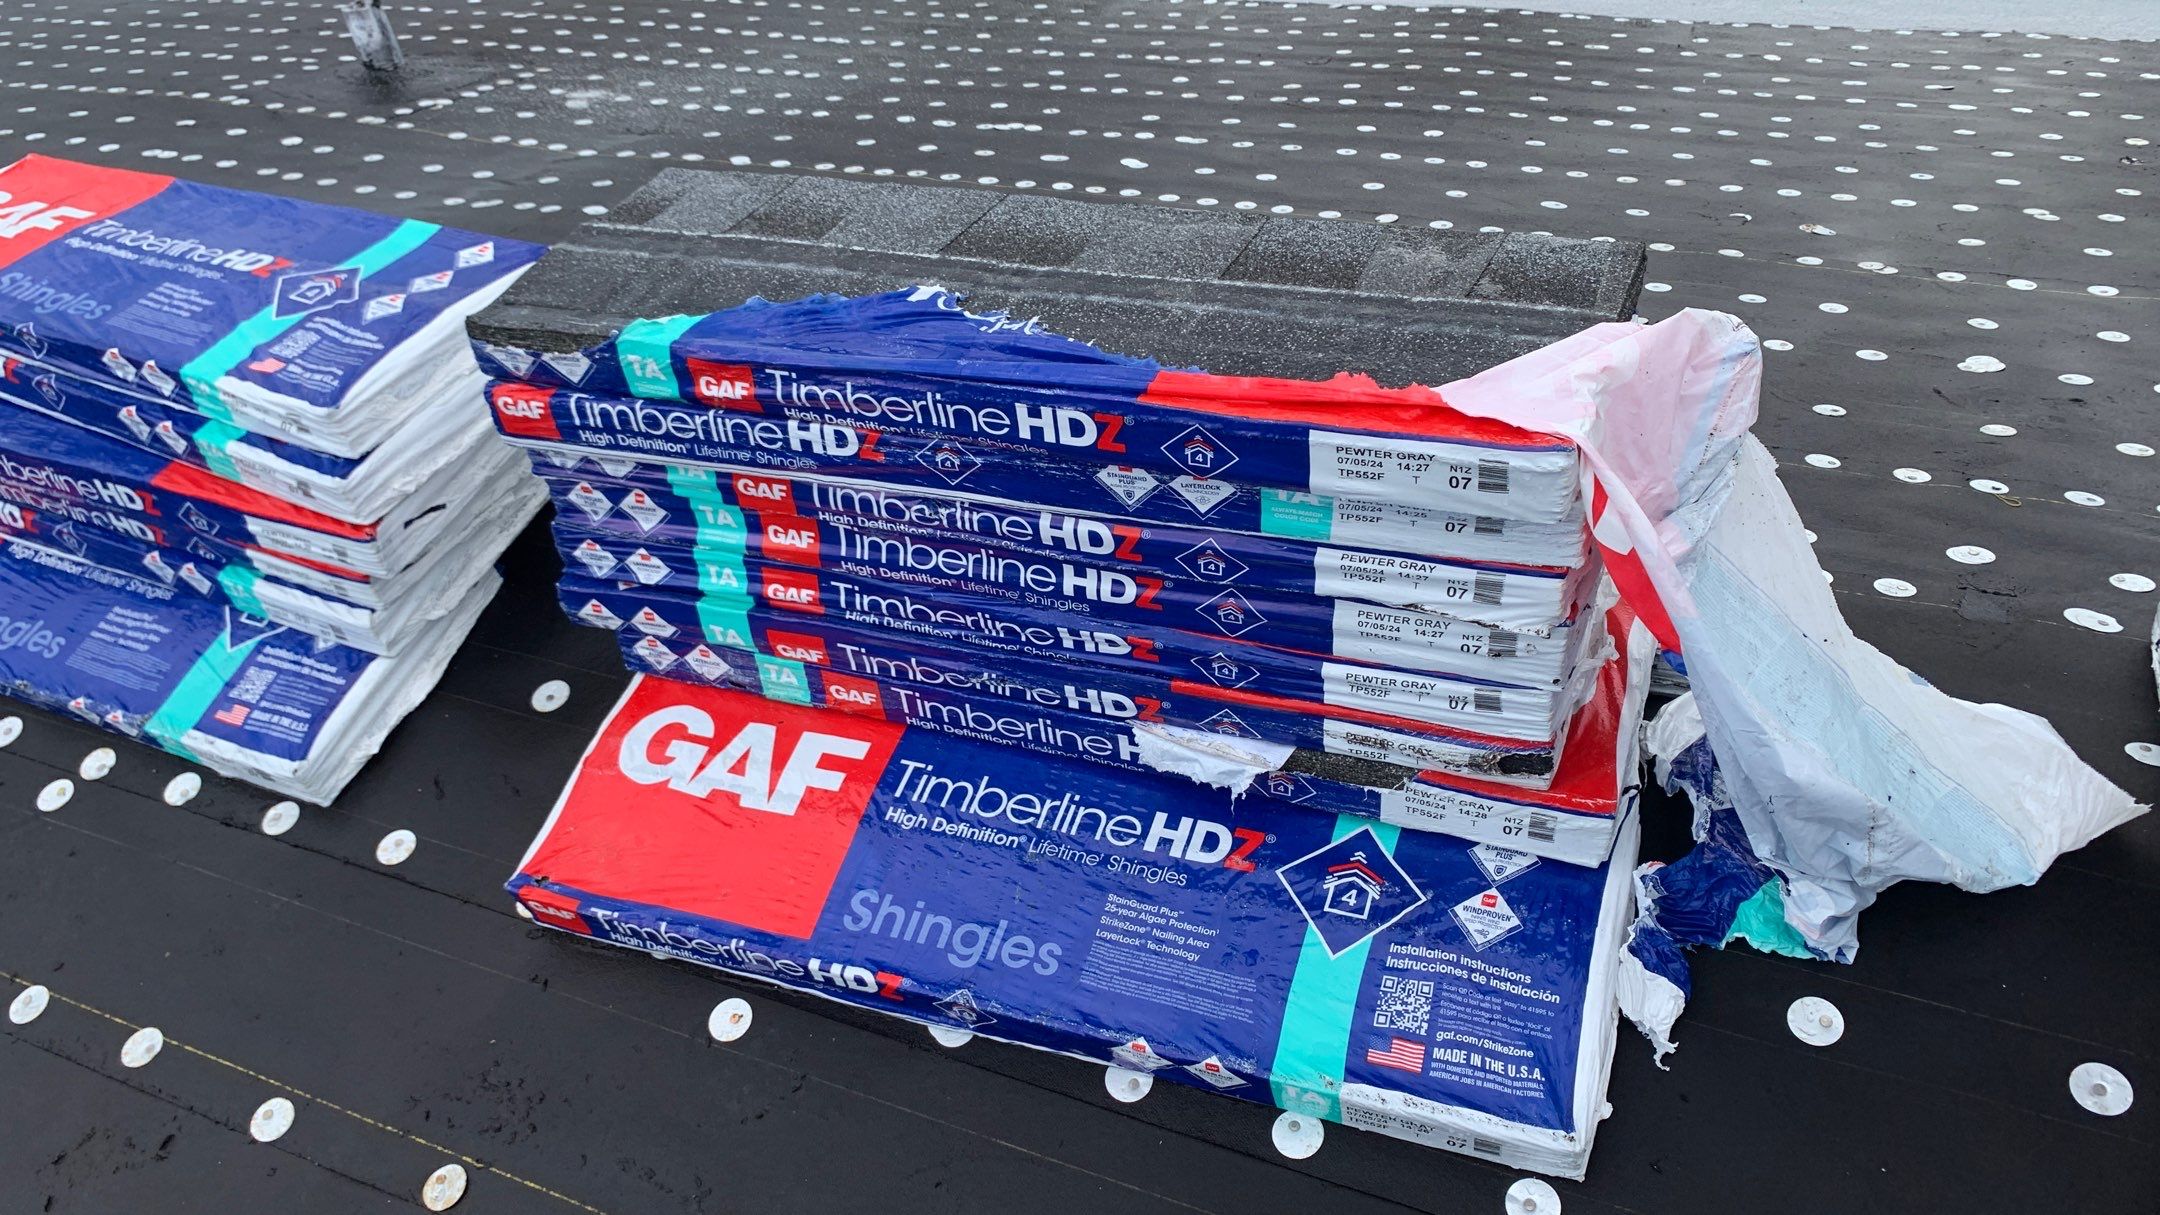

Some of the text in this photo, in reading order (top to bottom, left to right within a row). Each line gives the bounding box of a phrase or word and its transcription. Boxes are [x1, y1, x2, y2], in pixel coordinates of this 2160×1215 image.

[0, 271, 111, 320] Shingles
[625, 354, 668, 381] TA
[699, 374, 751, 401] GAF
[497, 396, 546, 420] GAF
[784, 406, 820, 423] High
[579, 429, 614, 447] High
[755, 451, 818, 470] Shingles
[1195, 453, 1204, 464] 4
[1336, 446, 1437, 462] PEWTER GRAY
[943, 459, 953, 469] 4
[1337, 456, 1430, 472] 07/05/24 14:27
[1449, 464, 1473, 475] N1Z
[0, 453, 162, 516] berlineHDZ
[1337, 468, 1421, 485] TP552F T
[1448, 475, 1473, 490] 07
[736, 478, 788, 501] GAF
[697, 504, 738, 529] TA
[818, 510, 852, 525] High
[1337, 503, 1383, 513] 07/05/24
[1338, 512, 1384, 524] TP552F
[767, 524, 816, 549] GAF
[1444, 521, 1469, 534] 07
[1207, 562, 1217, 571] 4
[1340, 564, 1429, 581] 07/05/24 14:27
[1341, 553, 1438, 574] PEWTER GRAY
[705, 564, 739, 588] TA
[1341, 572, 1388, 584] TP552F
[1447, 579, 1470, 587] N1Z
[767, 583, 816, 604] GAF
[840, 559, 877, 577] High
[1024, 591, 1091, 614] Shingles
[1446, 586, 1469, 600] 07
[845, 609, 880, 625] High
[1357, 610, 1452, 630] PEWTER GRAY
[709, 624, 746, 646] TA
[1357, 620, 1445, 639] 07/05/24 14:27
[1462, 633, 1484, 642] N1Z
[776, 643, 824, 663] GAF
[1460, 643, 1482, 655] 07
[763, 663, 799, 685] TA
[1345, 672, 1437, 691] PEWTER GRAY
[828, 684, 877, 705] GAF
[1349, 683, 1392, 699] TP552F
[1448, 699, 1470, 711] 07
[890, 687, 1140, 762] TimberlineH
[906, 716, 941, 731] High
[1397, 743, 1433, 756] GRAY
[618, 704, 872, 816] GAF
[1405, 785, 1495, 813] PEWTER GRAY
[1405, 795, 1488, 820] 07/05/24 14:28
[1405, 805, 1447, 820] TP552F
[1504, 816, 1525, 826] N1Z
[1502, 825, 1523, 837] 07
[884, 805, 928, 832] High
[1107, 854, 1188, 887] Shingles
[1107, 893, 1160, 914] StainGuard
[1341, 888, 1358, 906] 4
[528, 900, 577, 923] GAF
[1104, 902, 1138, 918] 25-year
[1138, 912, 1167, 926] Algae
[610, 931, 644, 948] High
[842, 887, 1063, 978] Shingles
[1152, 927, 1186, 945] Nailing
[1186, 936, 1210, 950] Area
[1146, 940, 1201, 962] Technology
[1389, 942, 1532, 984] Installation instructions
[1386, 955, 1560, 1004] Instrucciones de instalación
[1435, 1030, 1535, 1058] gaf.com/StrikeZone
[1431, 1061, 1446, 1070] WITH
[1446, 1064, 1474, 1076] DOMESTIC
[1473, 1070, 1486, 1079] AND
[1486, 1072, 1513, 1086] IMPORTED
[1432, 1047, 1546, 1081] MADE IN THE U.S.A.
[1429, 1070, 1460, 1082] AMERICAN
[1460, 1076, 1475, 1086] JOBS
[1482, 1081, 1512, 1094] AMERICAN
[1346, 1105, 1397, 1122] PEWTER
[1346, 1110, 1388, 1124] 07/05/24
[1446, 1139, 1468, 1150] 07
